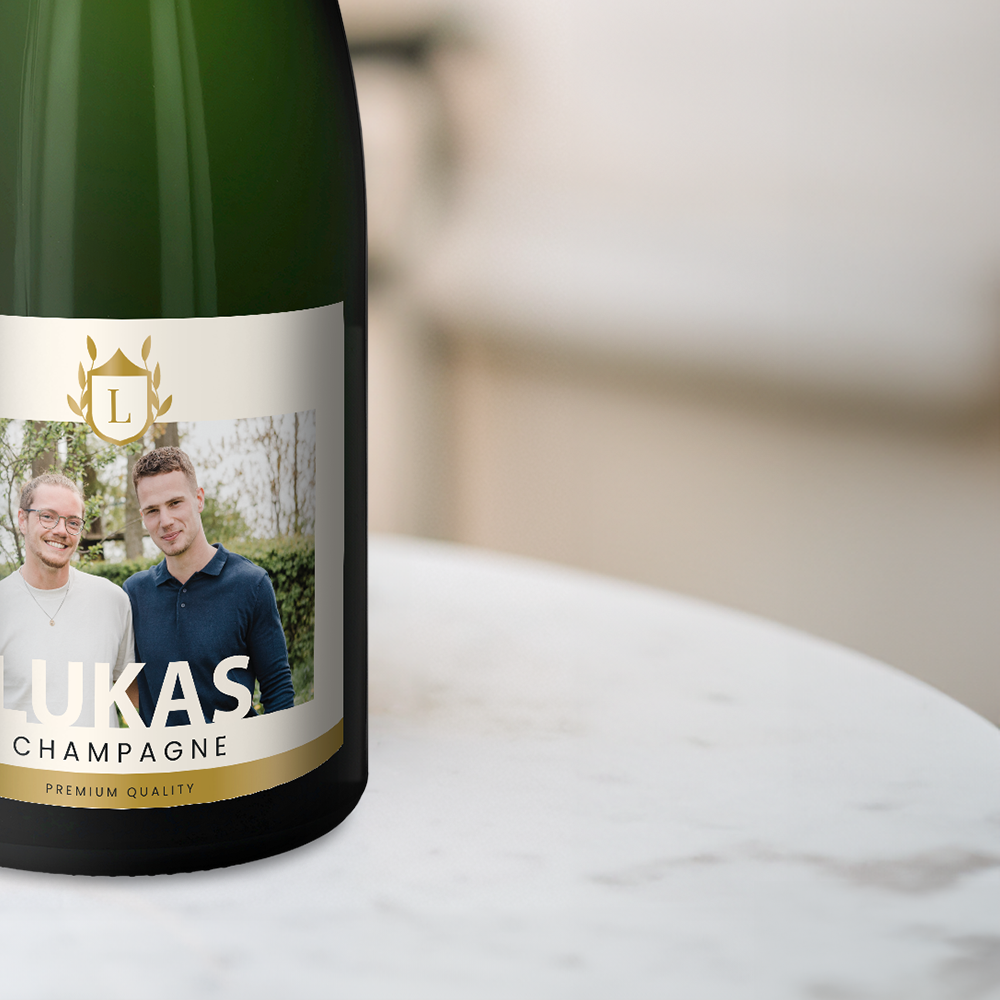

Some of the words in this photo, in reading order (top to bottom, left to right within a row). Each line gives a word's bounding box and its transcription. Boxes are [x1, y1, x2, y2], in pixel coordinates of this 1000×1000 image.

[108, 388, 130, 423] L
[12, 735, 228, 762] CHAMPAGNE
[45, 783, 119, 797] PREMIUM
[126, 783, 195, 799] QUALITY
